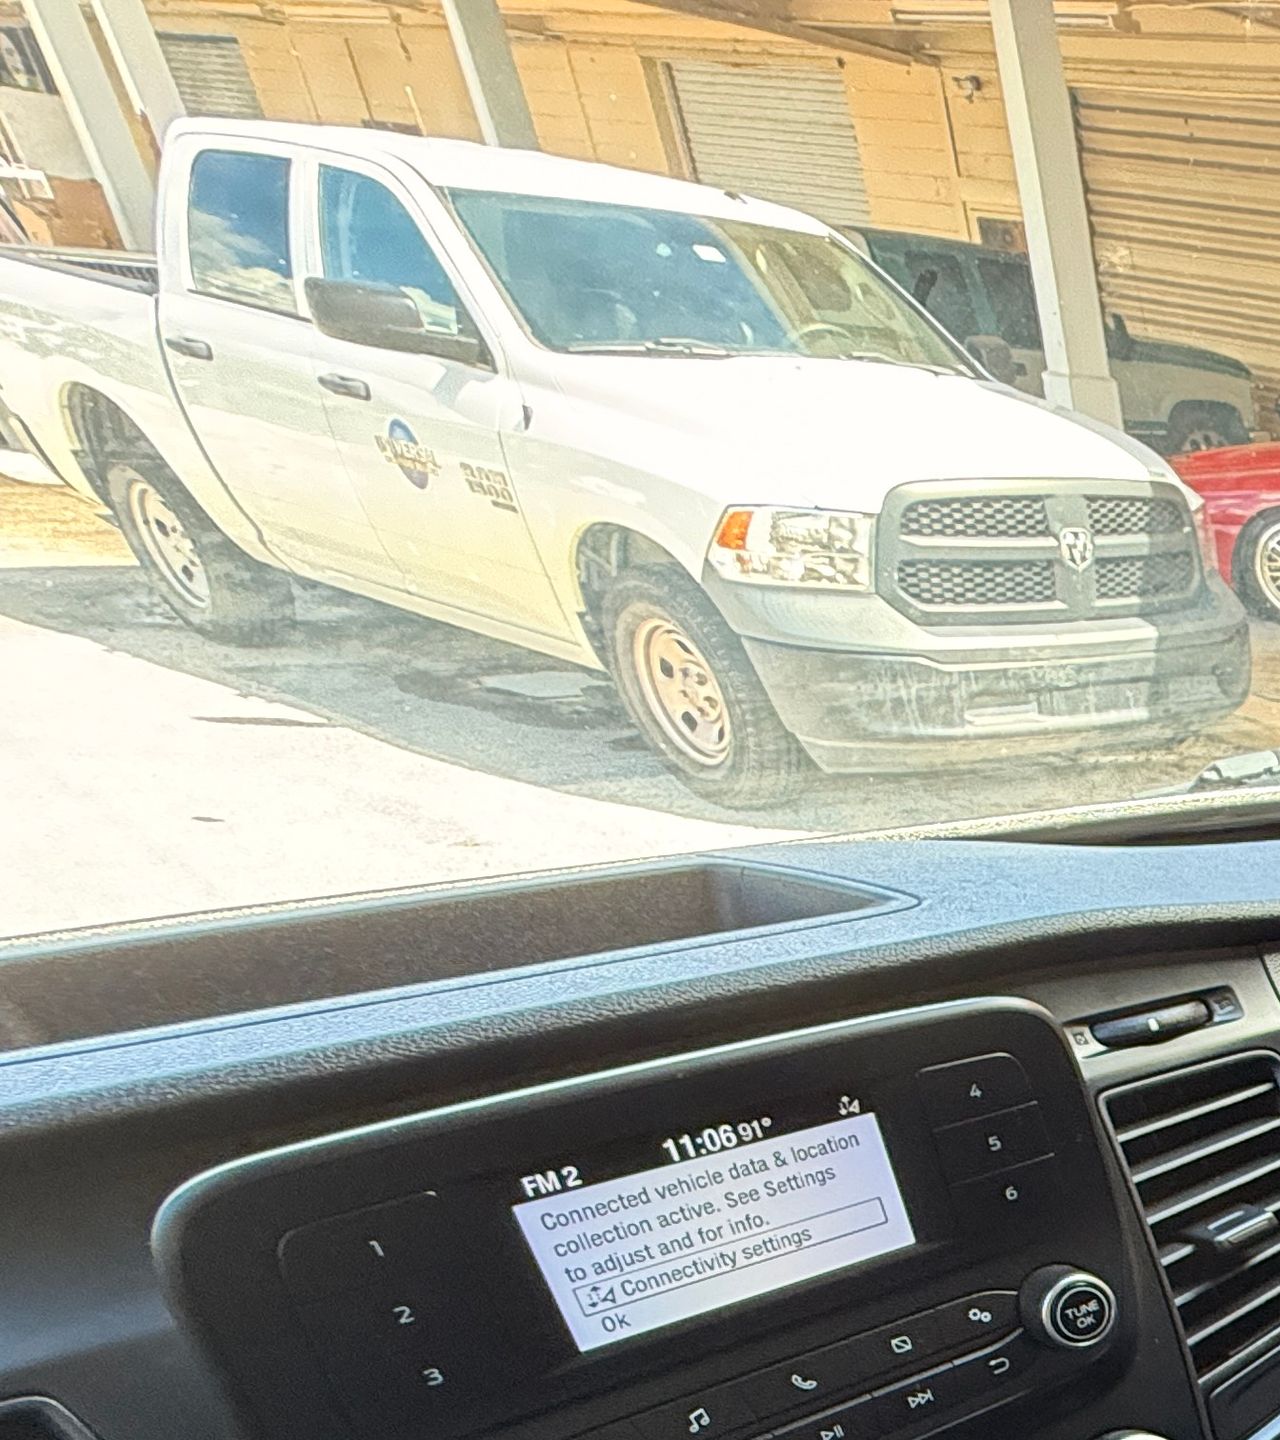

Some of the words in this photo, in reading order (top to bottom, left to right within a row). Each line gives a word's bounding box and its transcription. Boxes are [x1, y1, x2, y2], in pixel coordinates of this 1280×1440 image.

[970, 1083, 982, 1098] 4
[662, 1124, 738, 1162] 11:06
[988, 1135, 1001, 1151] 5
[520, 1170, 562, 1197] FM
[561, 1165, 583, 1187] 2
[540, 1187, 651, 1231] Connected
[654, 1170, 724, 1200] vehicle
[728, 1157, 770, 1180] data
[774, 1150, 788, 1167] &
[791, 1134, 860, 1163] location
[1005, 1186, 1018, 1201] 6
[553, 1219, 653, 1257] collection
[656, 1201, 721, 1228] active.
[724, 1188, 760, 1209] See
[763, 1167, 836, 1197] Settings
[369, 1240, 384, 1257] 1
[565, 1267, 587, 1283] to
[592, 1244, 655, 1276] adjust
[657, 1232, 694, 1256] and
[697, 1225, 723, 1244] for
[730, 1213, 770, 1235] info.
[620, 1250, 737, 1296] Connectivity
[743, 1228, 813, 1260] settings
[393, 1305, 415, 1324] 2
[1064, 1299, 1100, 1320] TUNE
[1076, 1313, 1097, 1329] OK
[423, 1367, 444, 1386] 3
